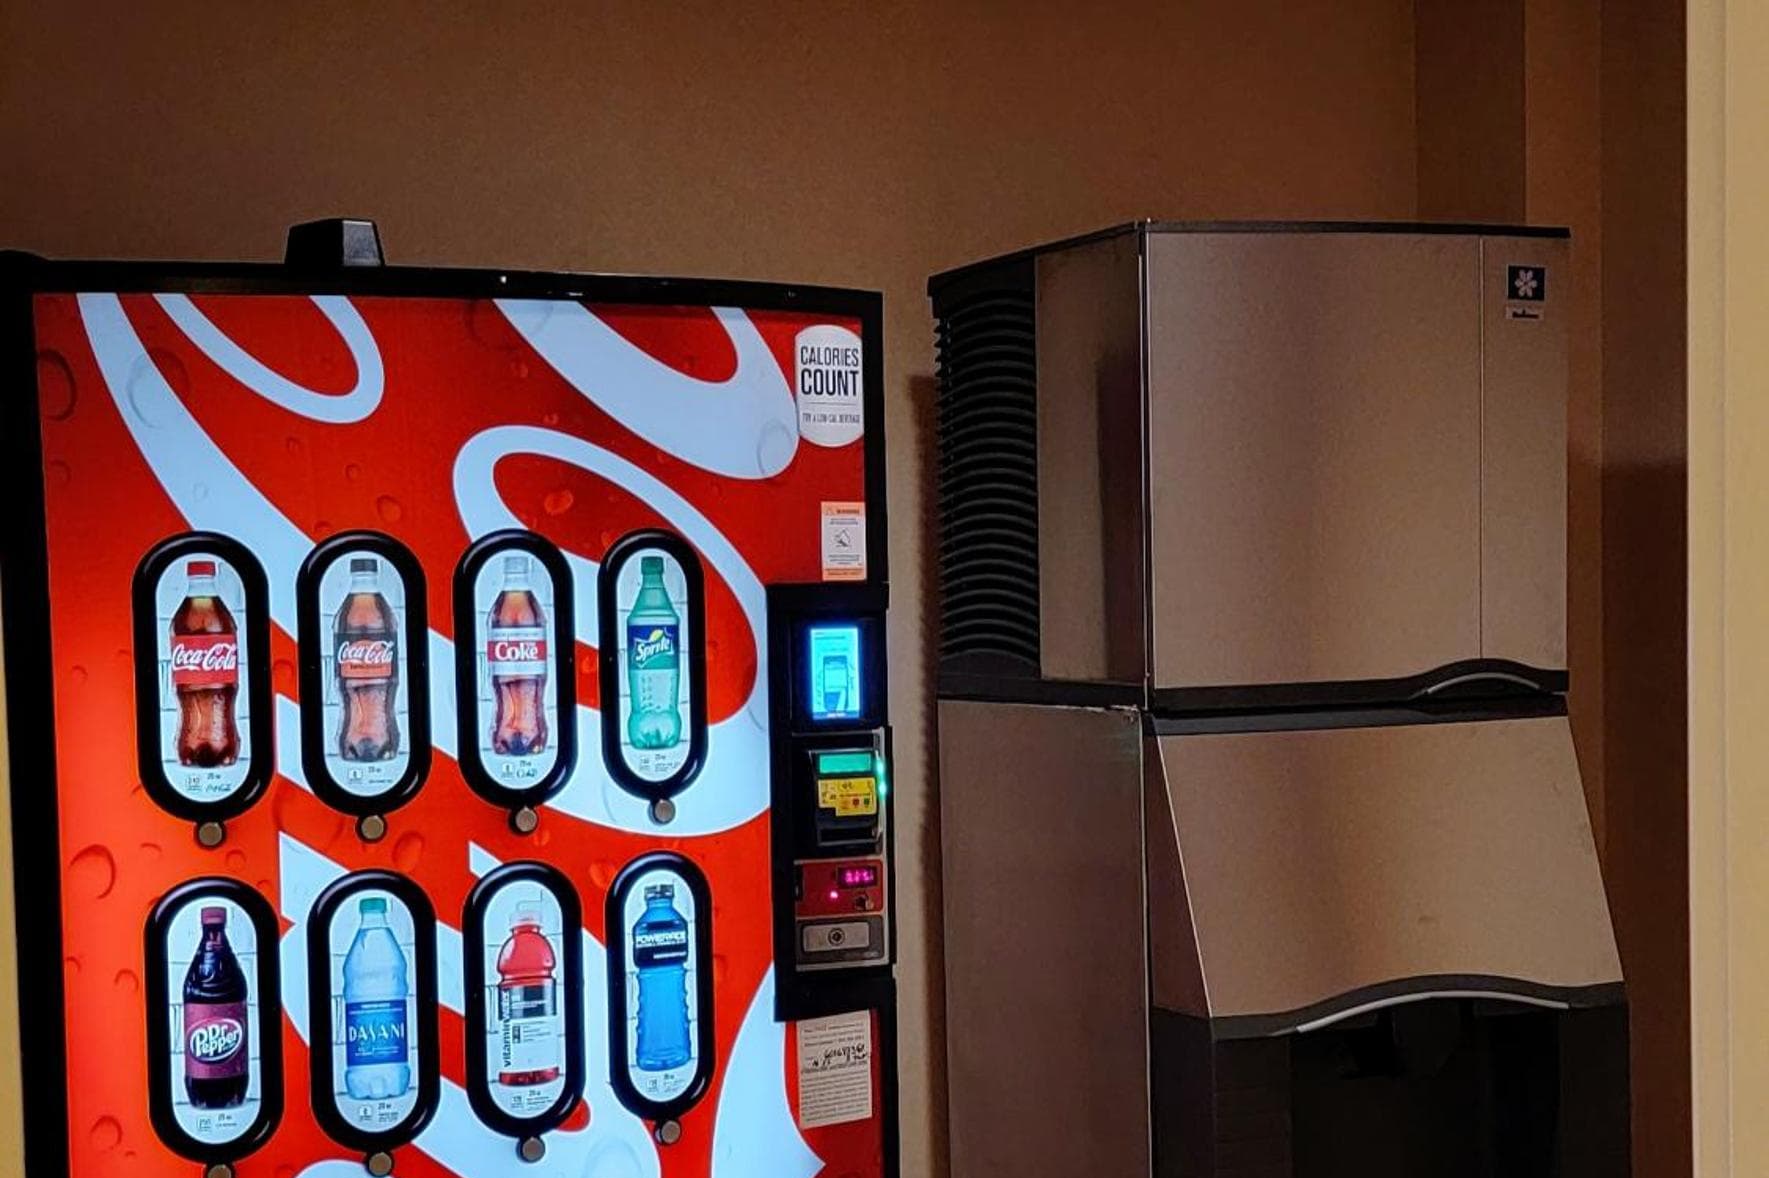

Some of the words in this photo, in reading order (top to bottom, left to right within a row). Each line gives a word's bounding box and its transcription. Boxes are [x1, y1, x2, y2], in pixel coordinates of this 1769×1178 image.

[800, 345, 859, 367] CALORIES
[801, 367, 859, 396] COUNT
[495, 642, 538, 661] Coke
[635, 636, 671, 662] Sprite
[195, 1027, 240, 1057] Pepper
[207, 1024, 228, 1041] Dr
[348, 1022, 405, 1042] DASANI
